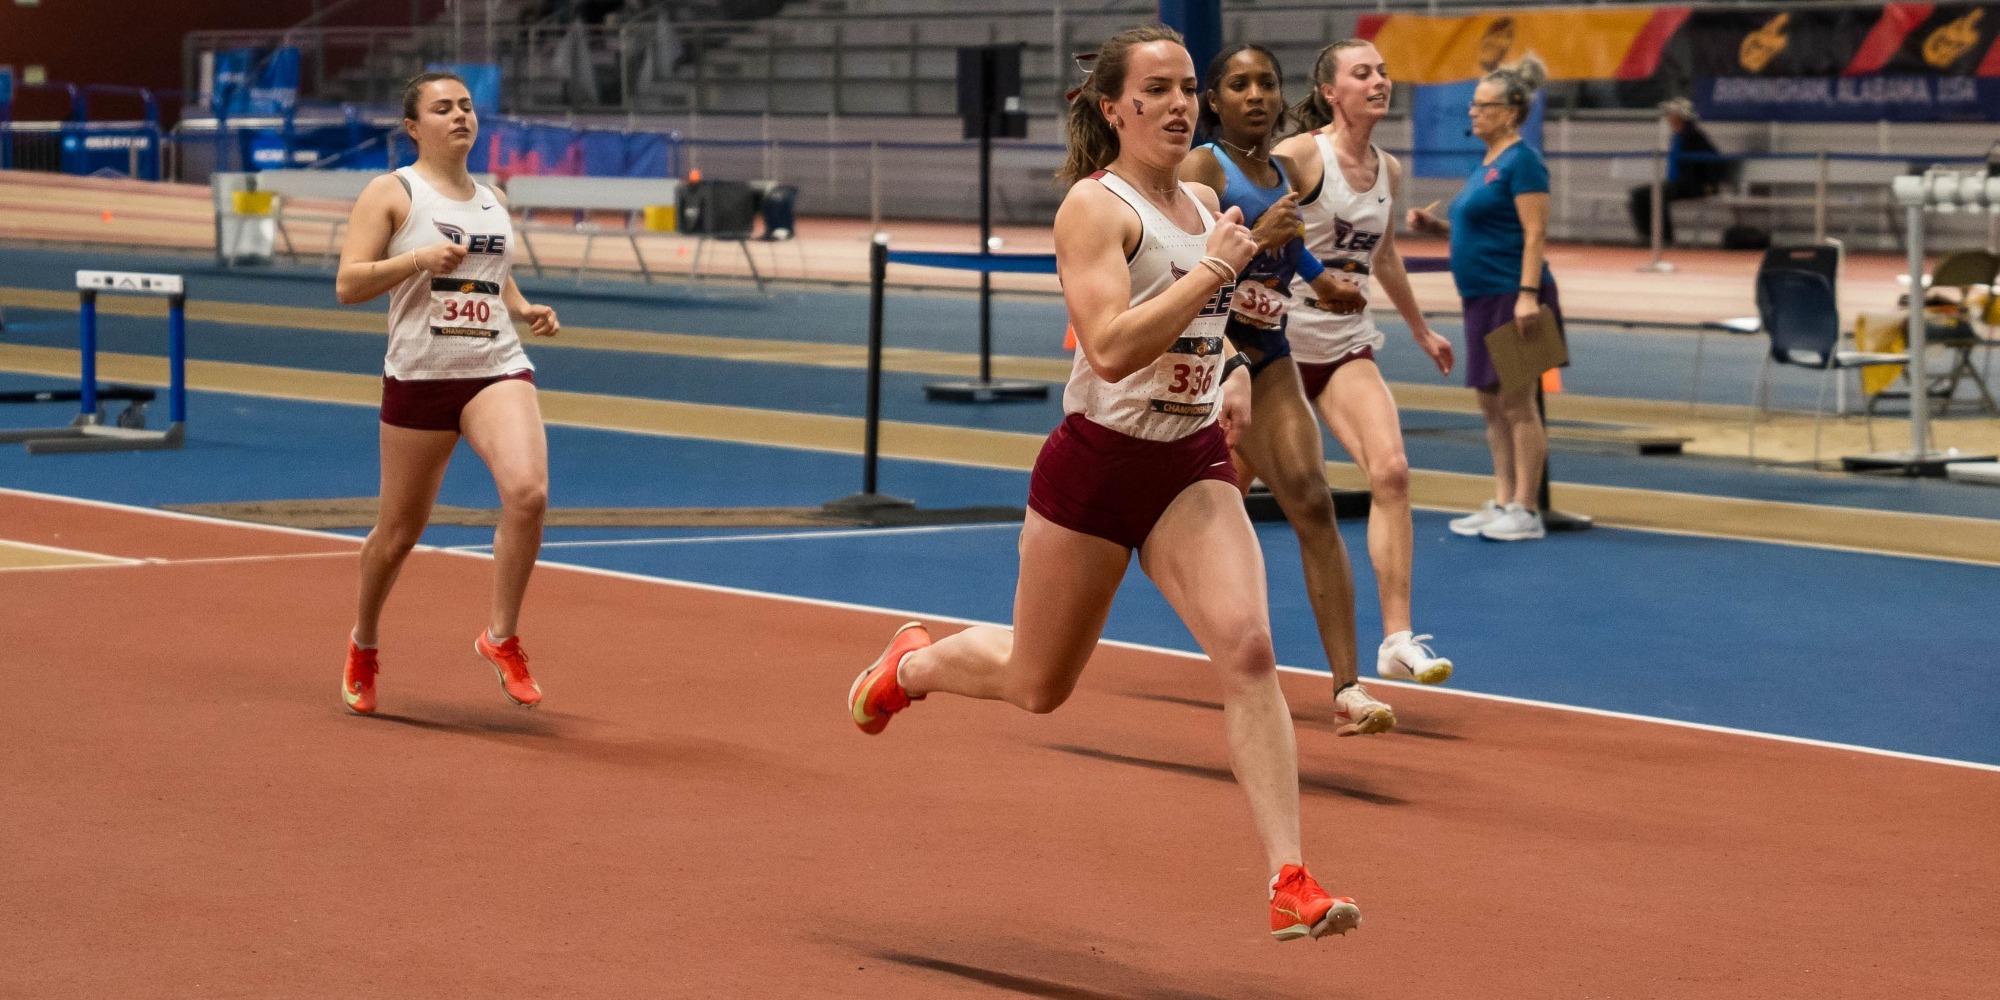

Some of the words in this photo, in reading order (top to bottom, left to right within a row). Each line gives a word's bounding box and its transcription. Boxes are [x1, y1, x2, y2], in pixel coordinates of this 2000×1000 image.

[442, 298, 491, 323] 340
[441, 327, 492, 338] CHAMPIONSHIPS
[1167, 363, 1215, 397] 336
